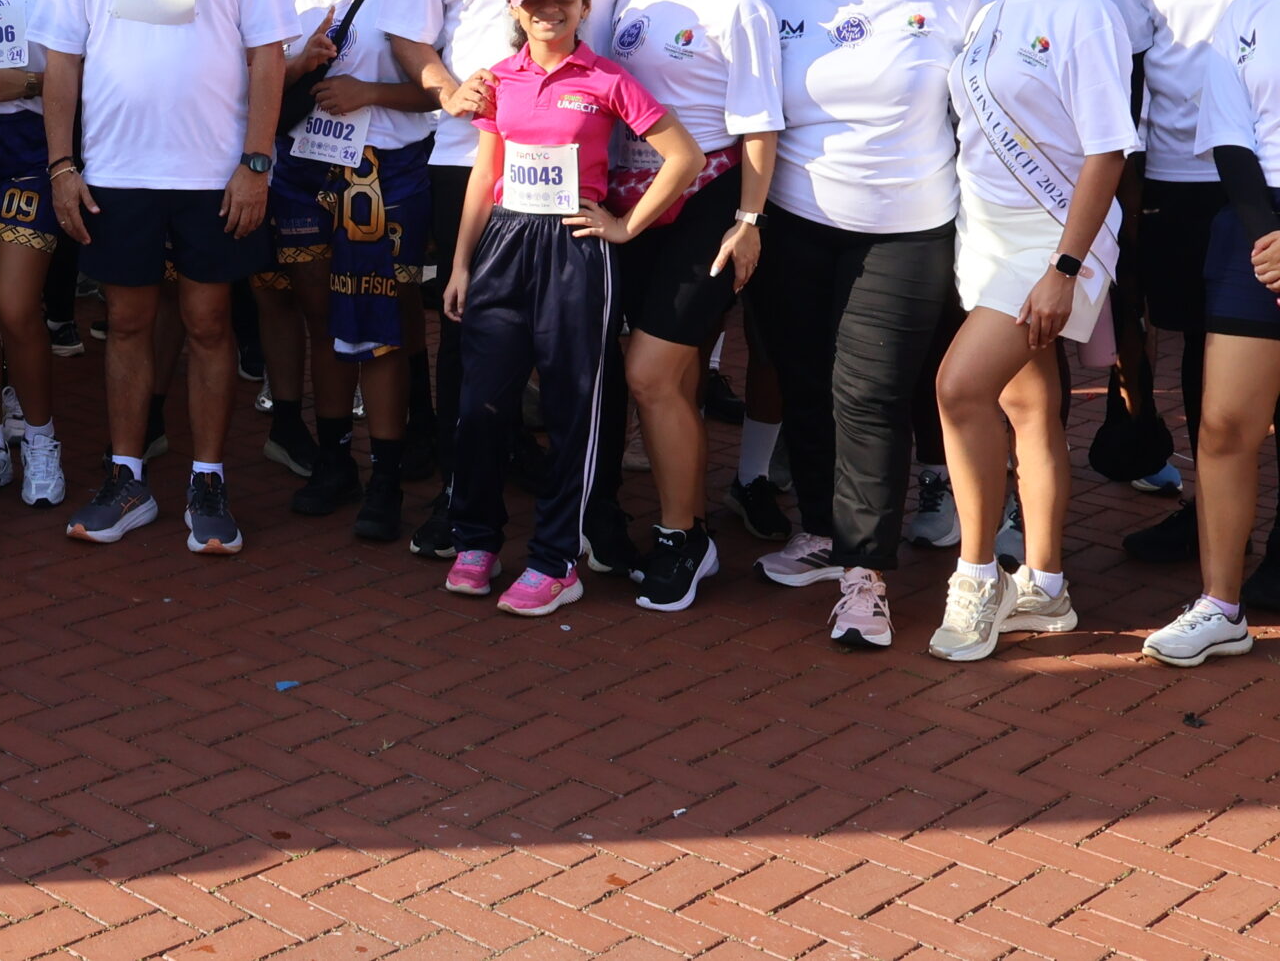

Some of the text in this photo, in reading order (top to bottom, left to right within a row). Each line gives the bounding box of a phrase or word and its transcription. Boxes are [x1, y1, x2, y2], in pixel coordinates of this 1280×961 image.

[10, 49, 22, 61] 24
[557, 100, 599, 114] UMECIT
[305, 116, 355, 141] 50002
[969, 75, 1069, 210] REINA UMECIT 2026
[343, 149, 356, 161] 24
[510, 164, 564, 186] 50043
[0, 188, 40, 222] 09
[557, 194, 570, 207] 24
[361, 272, 397, 297] FÍSIC
